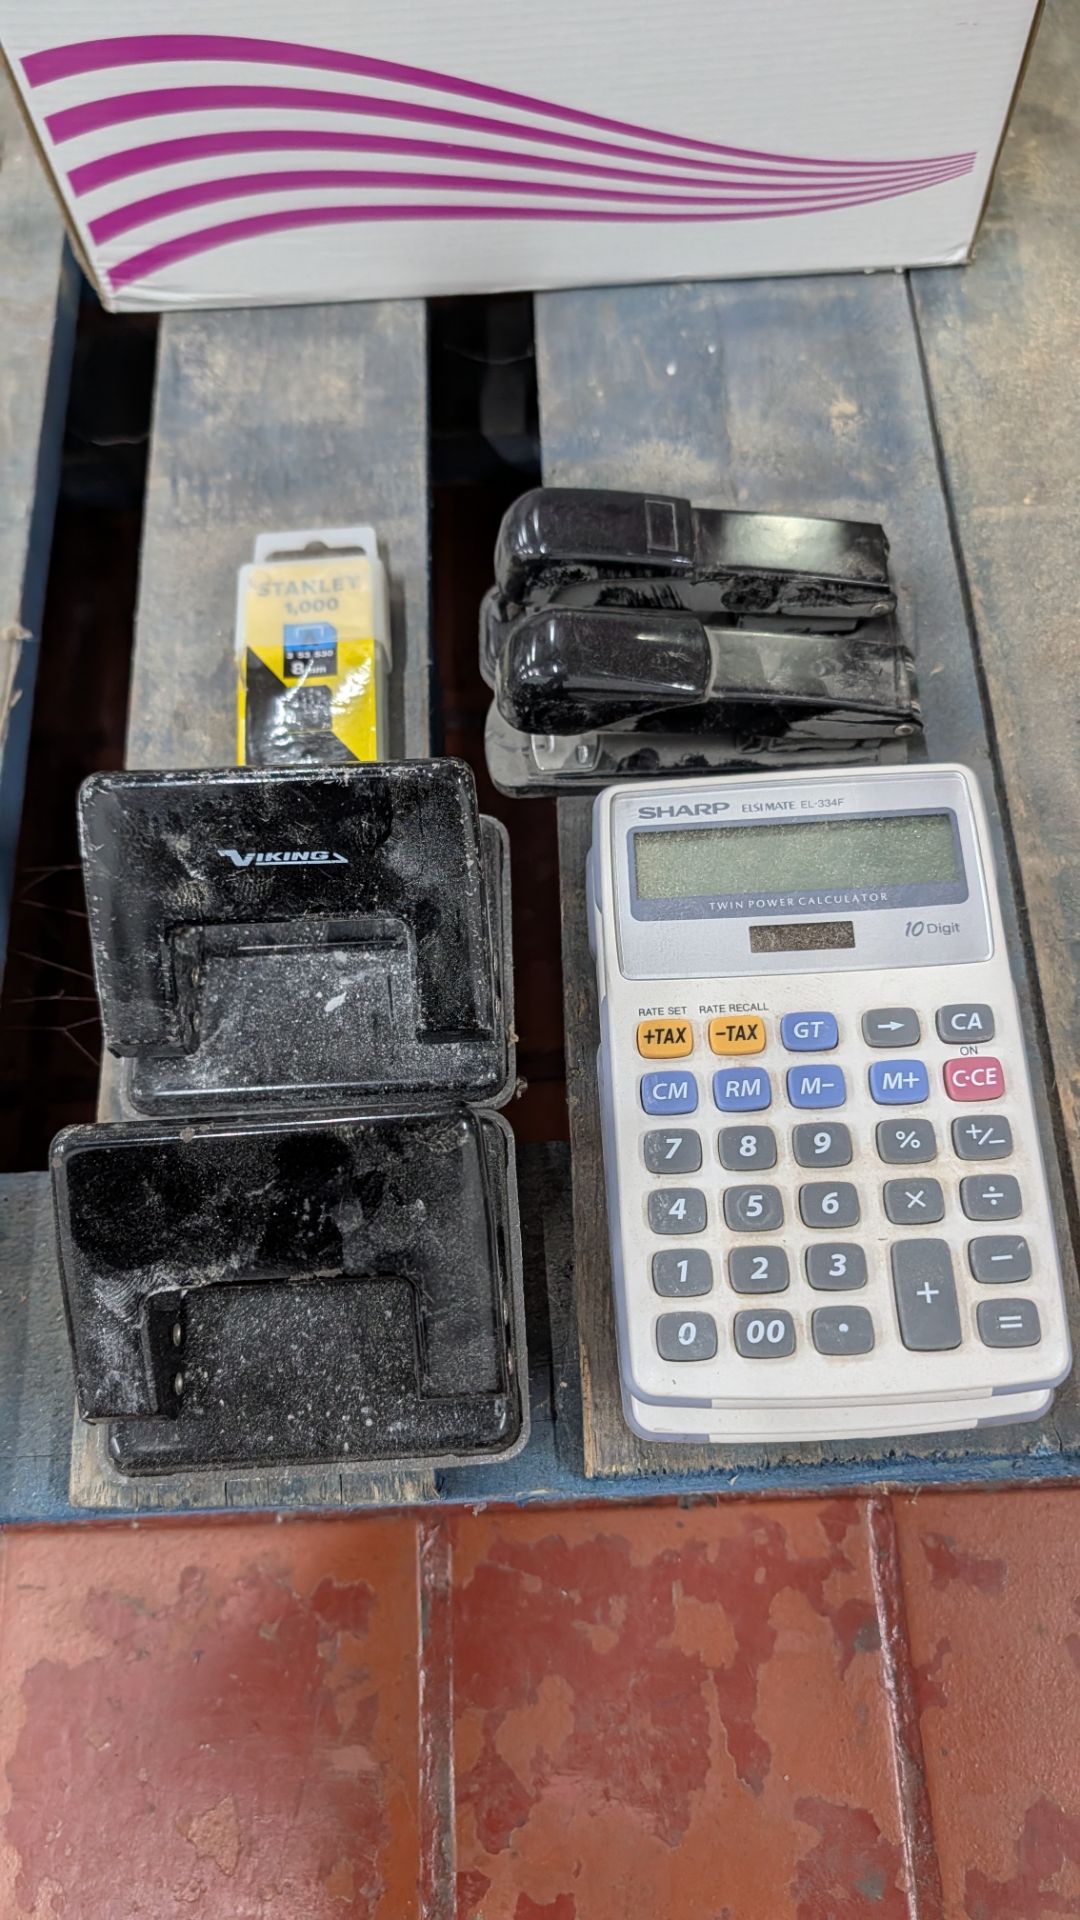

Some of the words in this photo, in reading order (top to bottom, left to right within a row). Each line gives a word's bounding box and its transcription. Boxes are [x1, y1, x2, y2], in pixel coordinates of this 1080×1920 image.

[257, 575, 361, 597] STANLEY
[284, 598, 339, 616] 1,000
[638, 801, 731, 820] SHARP
[800, 797, 845, 810] EL-334F
[217, 849, 349, 867] VIKING
[709, 901, 744, 911] TWIN
[748, 897, 794, 909] POWER
[798, 892, 888, 906] CALCULATOR
[905, 920, 924, 937] 10
[927, 921, 961, 936] Digit
[638, 1007, 665, 1017] RATE
[667, 1006, 687, 1015] SET
[699, 1004, 726, 1014] RATE
[729, 1002, 769, 1013] RECALL
[793, 1021, 824, 1039] GT
[951, 1012, 983, 1031] CA
[643, 1027, 687, 1045] +TAX
[715, 1024, 759, 1042] -TAX
[959, 1045, 979, 1056] ON
[652, 1081, 688, 1100] CM
[725, 1078, 761, 1098] RM
[800, 1077, 835, 1096] M-
[882, 1071, 920, 1091] M+
[665, 1138, 682, 1159] 7
[739, 1135, 757, 1157] 8
[813, 1132, 832, 1155] 9
[895, 1130, 921, 1150] %
[668, 1198, 687, 1220] 4
[746, 1194, 764, 1218] 5
[821, 1191, 840, 1215] 6
[676, 1260, 689, 1283] 1
[751, 1257, 769, 1280] 2
[828, 1253, 847, 1277] 3
[678, 1322, 696, 1346] 0
[746, 1319, 785, 1344] 00
